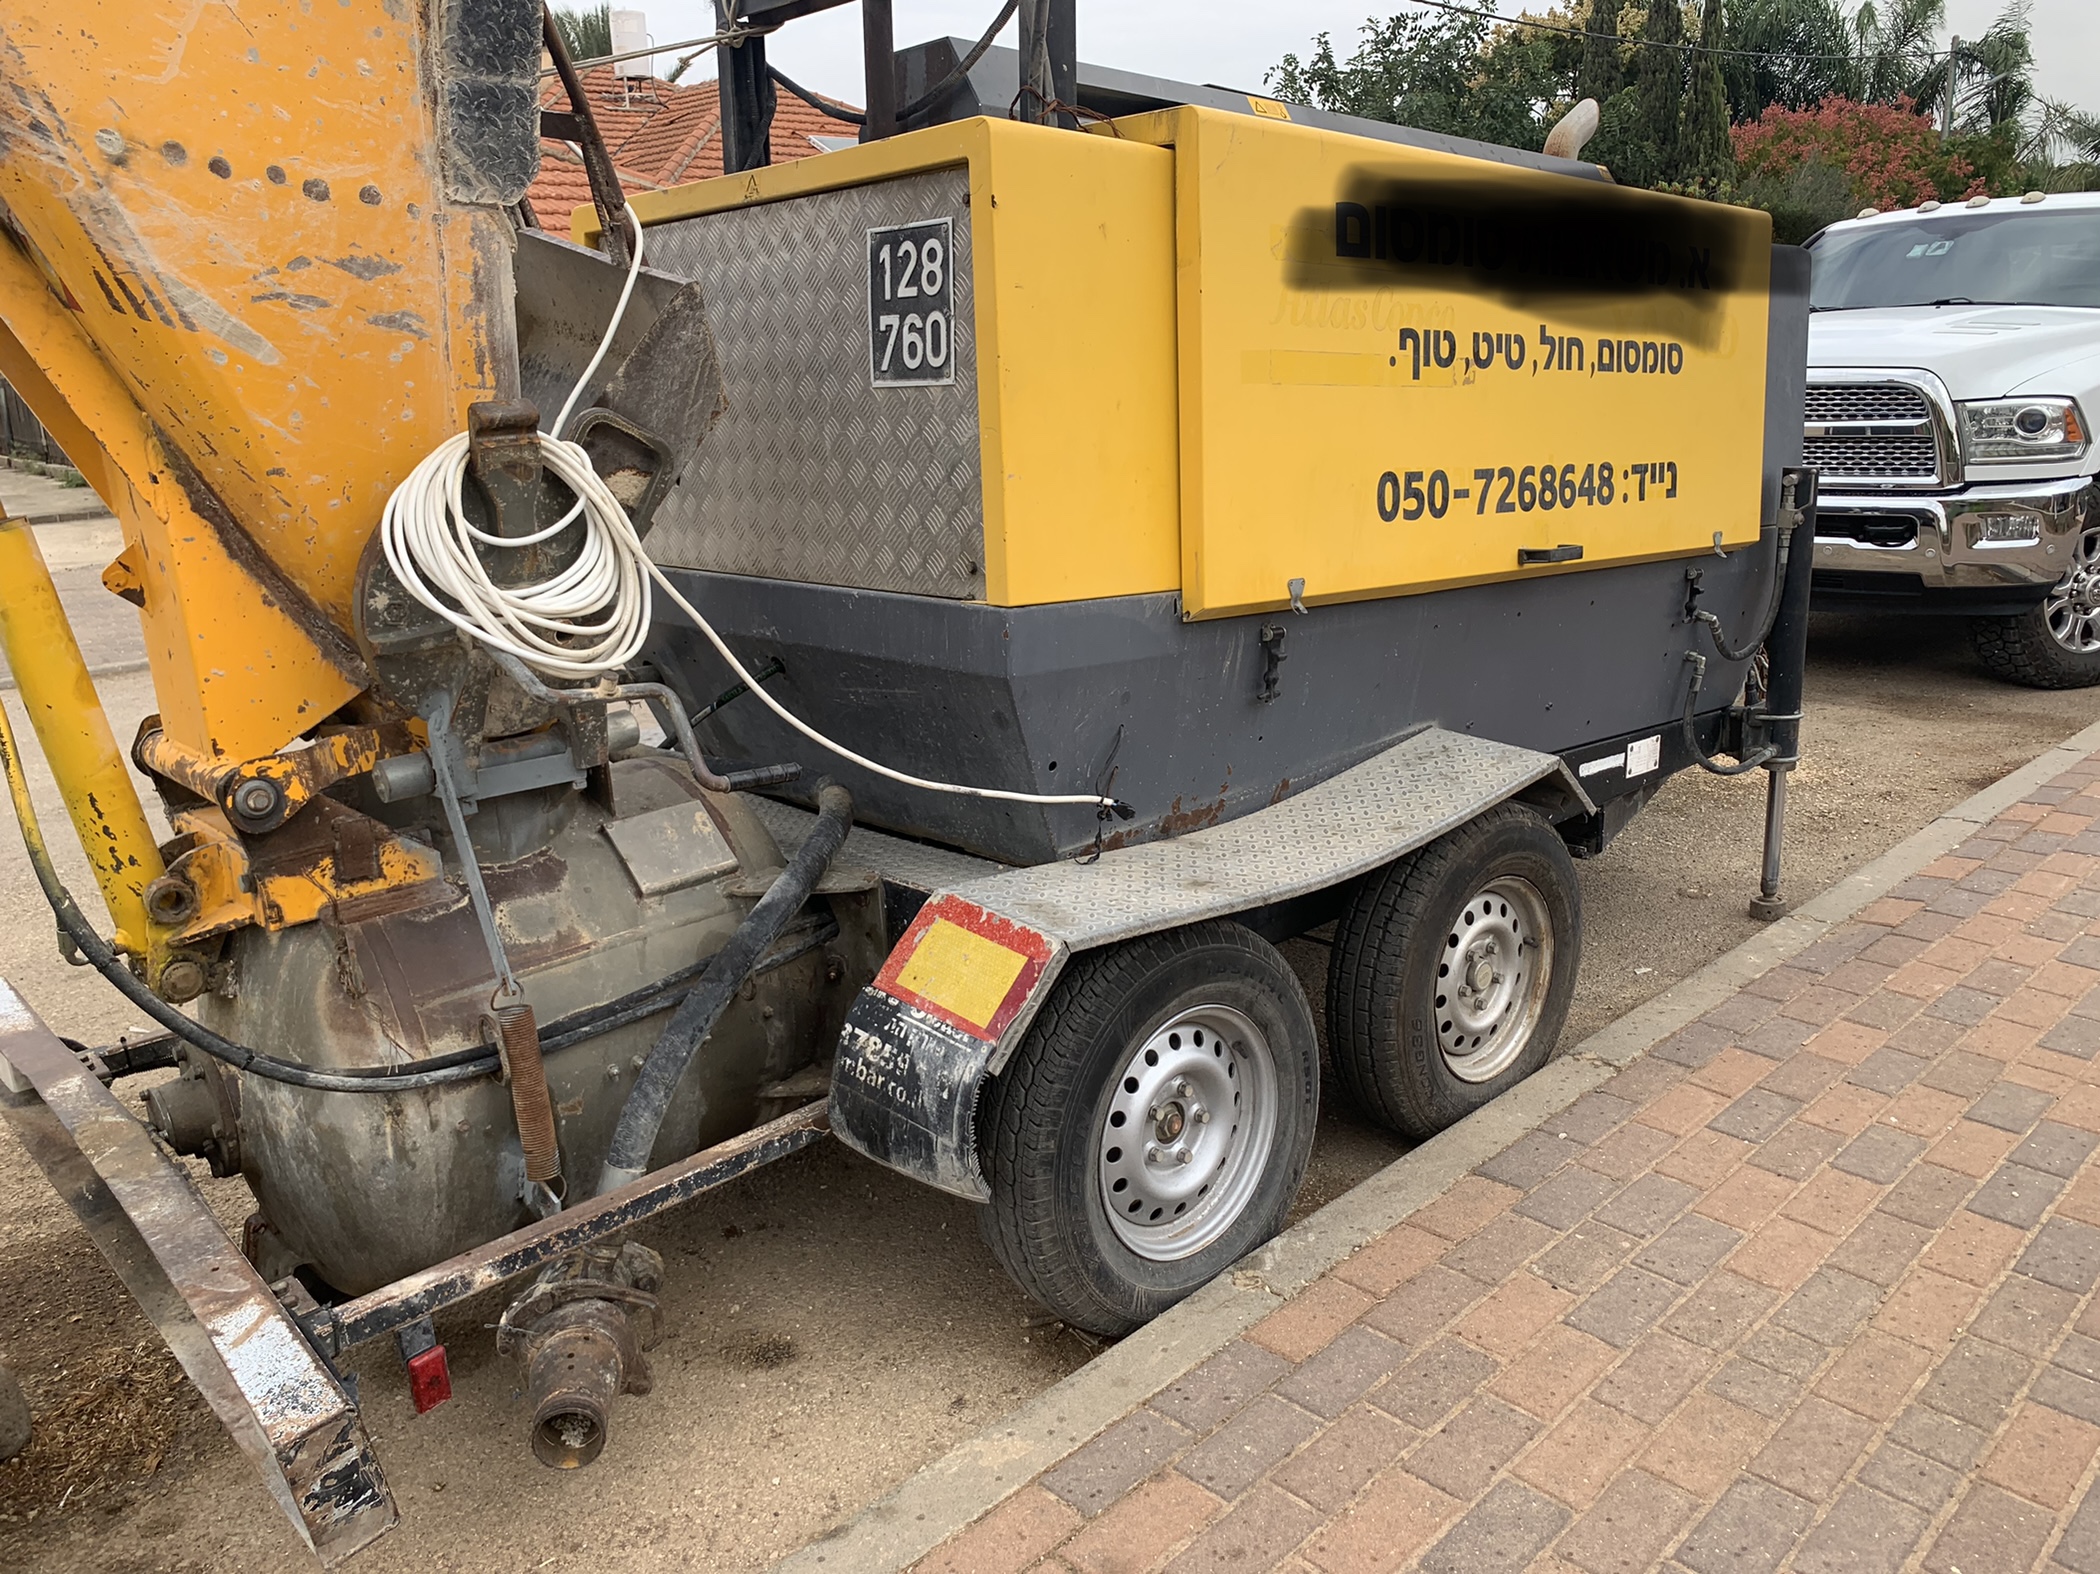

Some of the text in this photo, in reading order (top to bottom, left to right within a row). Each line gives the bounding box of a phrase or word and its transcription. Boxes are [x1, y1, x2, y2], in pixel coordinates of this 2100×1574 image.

[879, 238, 943, 300] 128
[879, 310, 947, 372] 760
[1389, 327, 1457, 381] טוף.
[1463, 332, 1526, 376] טיט,
[1532, 325, 1585, 376] חול,
[1590, 338, 1684, 379] סומסום,
[1376, 461, 1677, 522] נייד: 050-7268648
